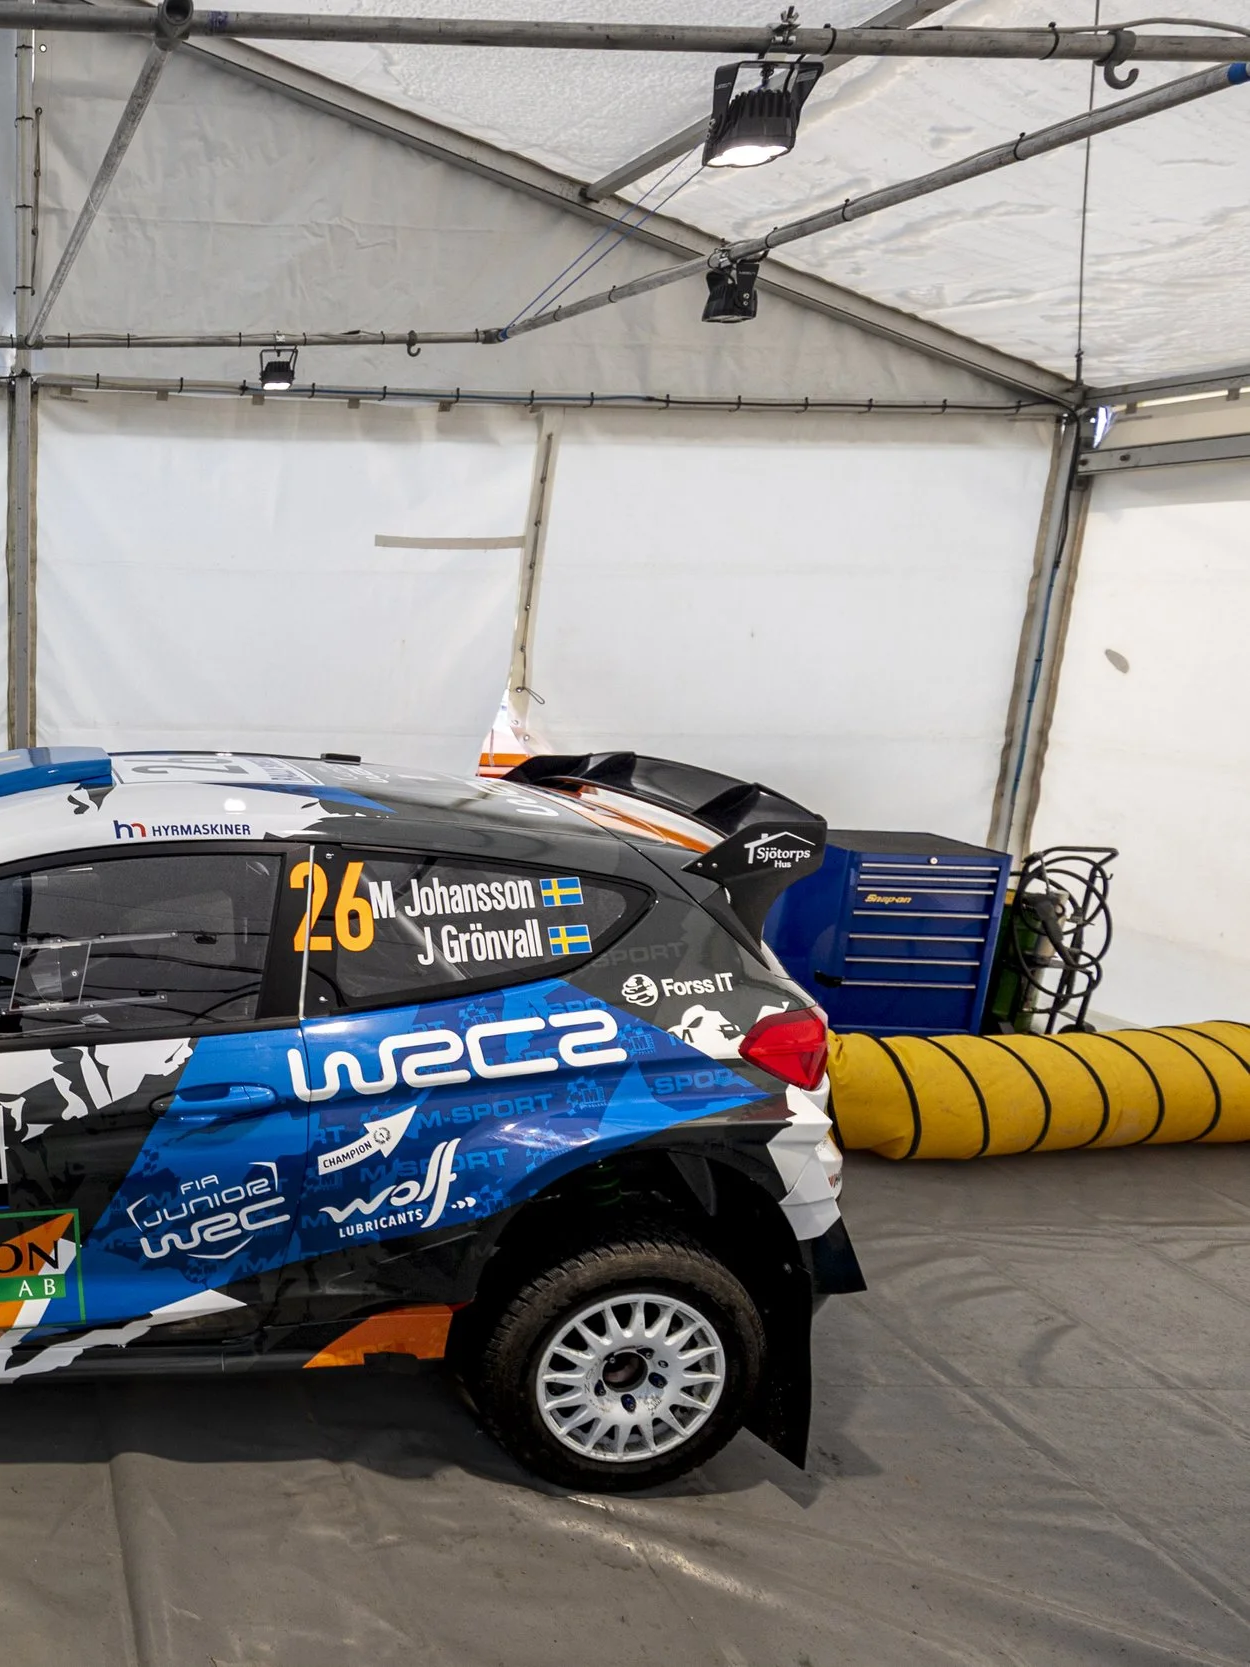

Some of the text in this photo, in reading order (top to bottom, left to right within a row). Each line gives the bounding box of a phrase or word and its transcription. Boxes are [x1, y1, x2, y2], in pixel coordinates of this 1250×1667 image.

[151, 823, 251, 837] HYRMASKINER
[756, 847, 811, 863] Sjötorps
[774, 860, 792, 868] Hus
[289, 861, 375, 953] 26
[368, 877, 536, 920] M Johansson
[864, 893, 913, 905] Snap-on
[417, 918, 544, 966] J Grönvall
[660, 972, 734, 997] Forss IT
[288, 1009, 628, 1102] WRC2
[322, 1140, 373, 1169] CHAMPION
[180, 1174, 219, 1195] FIA
[318, 1137, 462, 1229] wolf
[143, 1177, 272, 1228] JUNIOR
[139, 1196, 291, 1259] WRC
[338, 1208, 424, 1239] LUBRICANTS
[18, 1277, 57, 1298] AB
